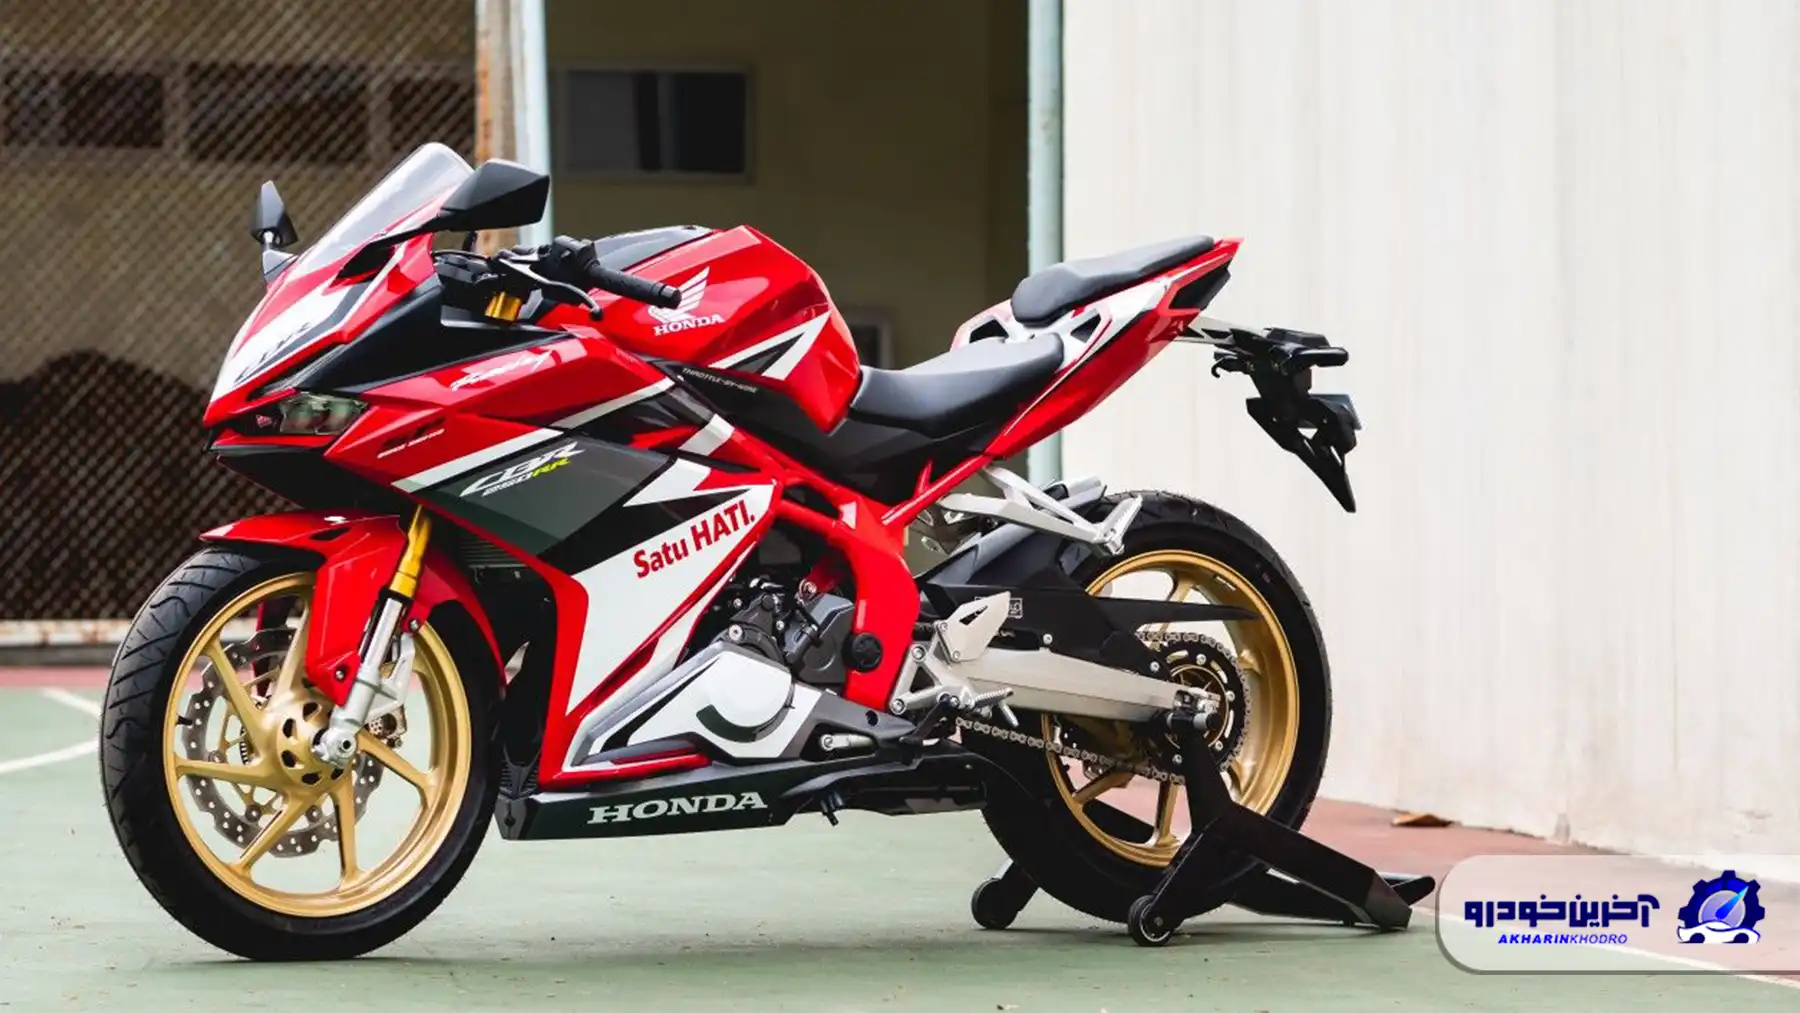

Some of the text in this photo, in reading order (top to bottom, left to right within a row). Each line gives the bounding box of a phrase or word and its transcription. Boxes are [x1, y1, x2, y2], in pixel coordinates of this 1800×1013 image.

[652, 313, 726, 337] HONDA
[459, 441, 586, 498] CBR
[633, 499, 756, 579] Satu HATI.
[587, 791, 769, 824] HONDA
